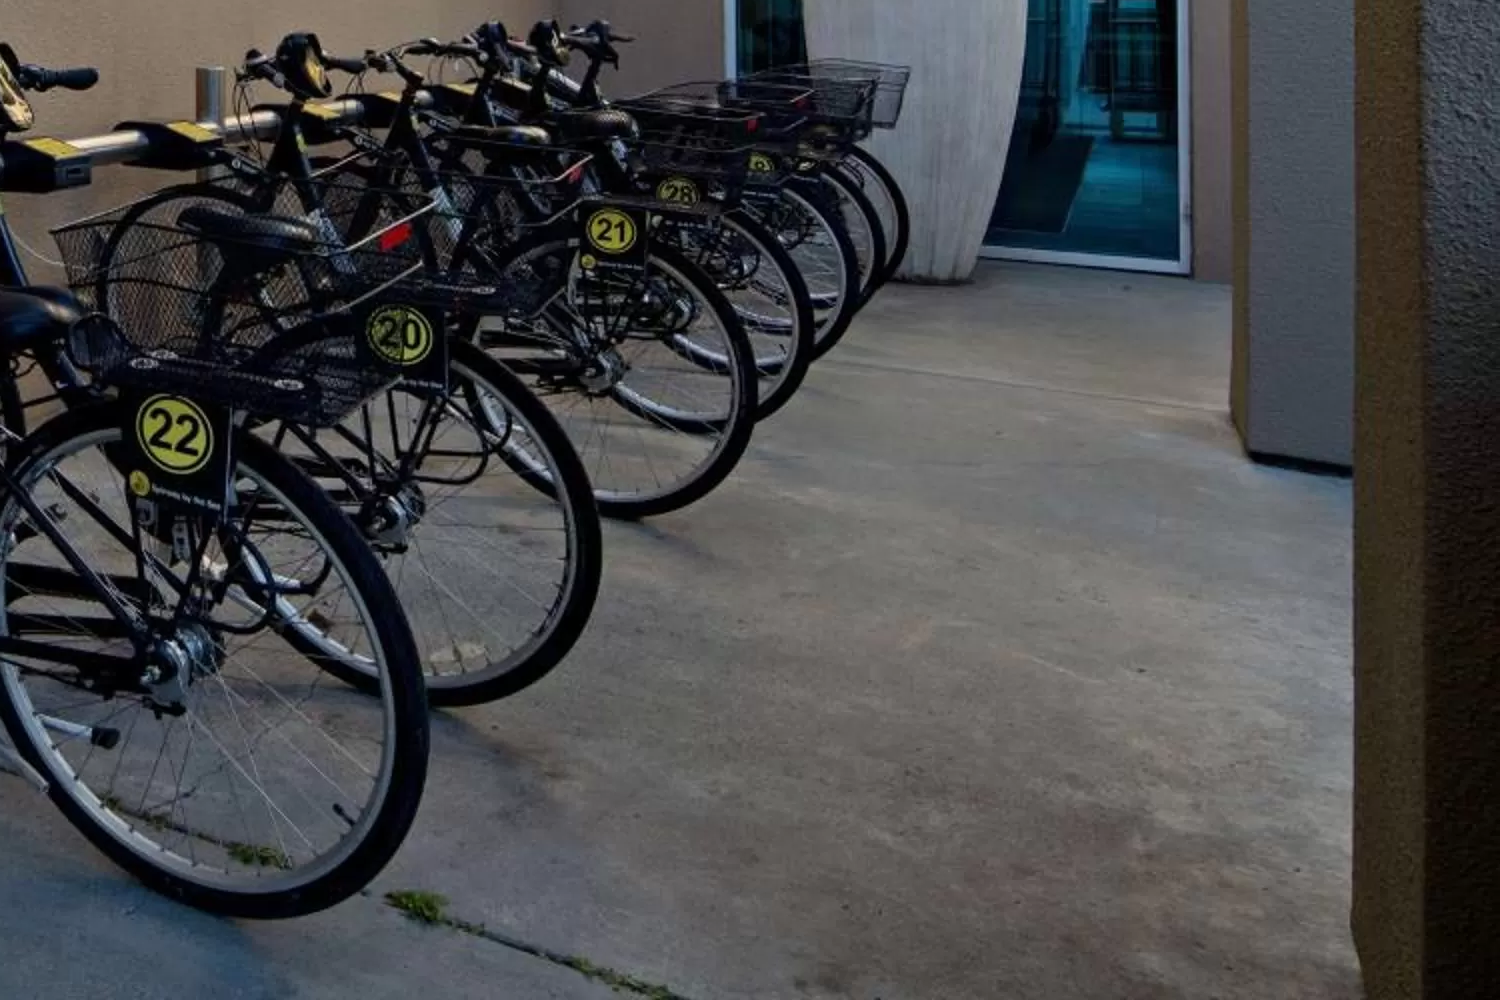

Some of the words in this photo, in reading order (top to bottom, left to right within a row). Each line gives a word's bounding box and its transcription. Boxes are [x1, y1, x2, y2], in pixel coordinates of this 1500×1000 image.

[597, 218, 627, 242] 21
[379, 316, 420, 349] 20
[149, 407, 199, 456] 22
